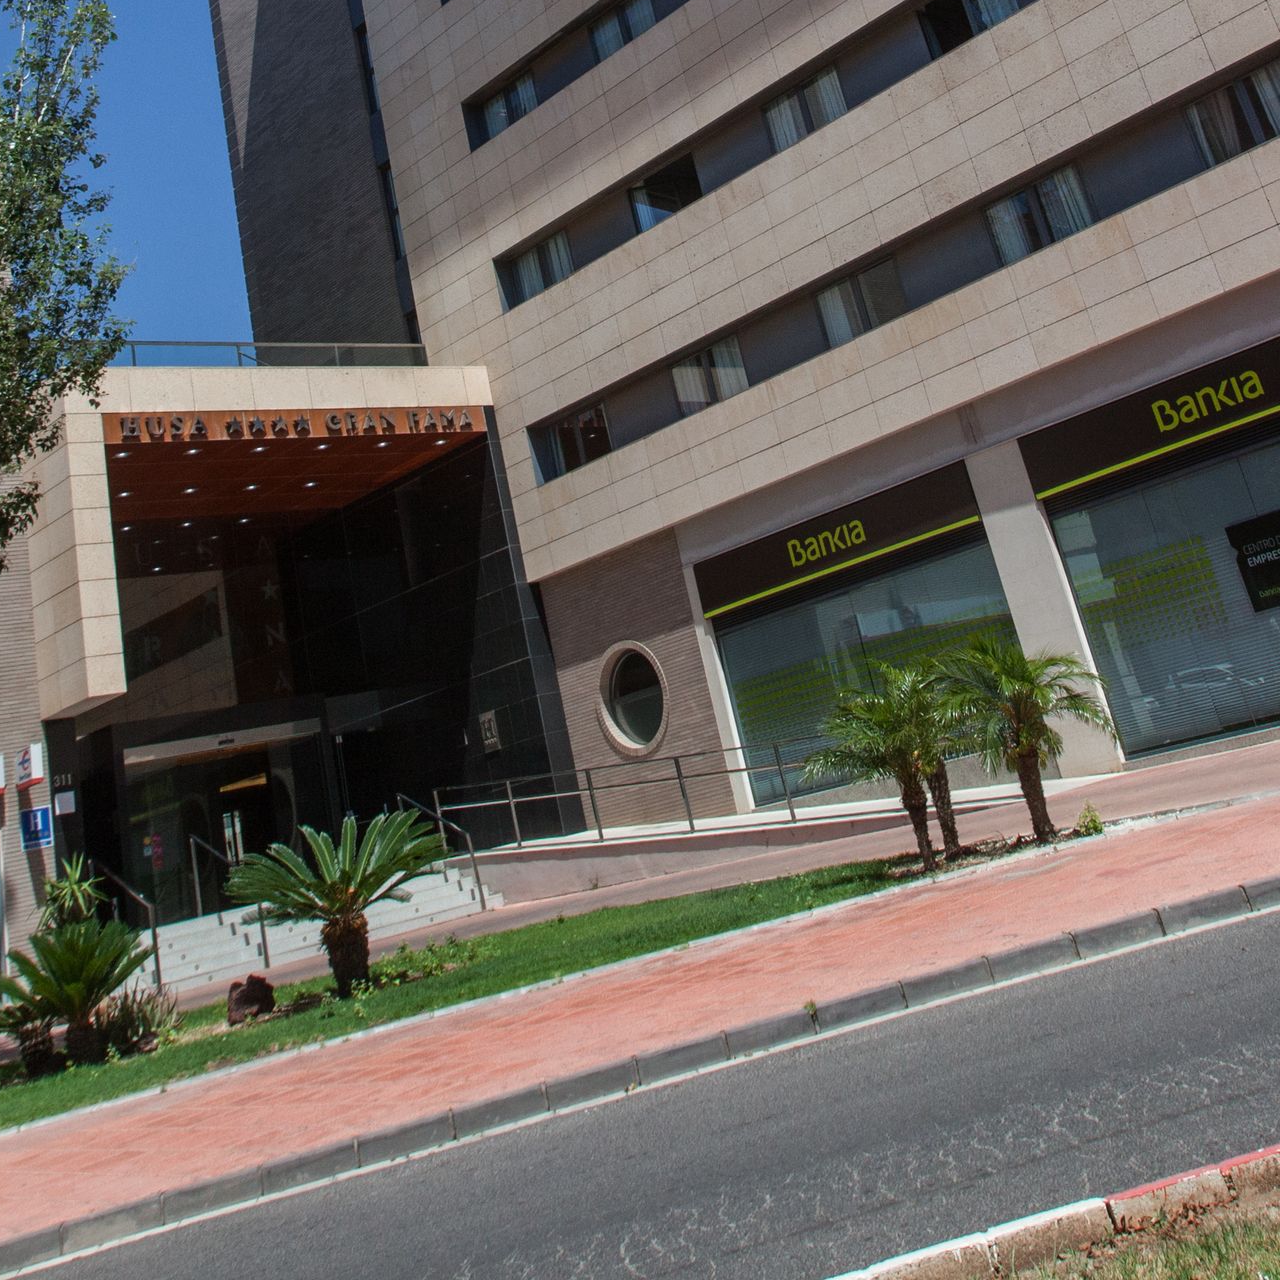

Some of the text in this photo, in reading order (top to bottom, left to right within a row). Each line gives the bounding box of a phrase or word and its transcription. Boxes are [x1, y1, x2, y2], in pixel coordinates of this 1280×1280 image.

[1150, 370, 1265, 432] Bankia
[120, 408, 471, 437] HUSA GRAN FAMA
[787, 520, 867, 568] Bankia
[1242, 537, 1276, 555] CENTRO
[54, 773, 71, 787] 311
